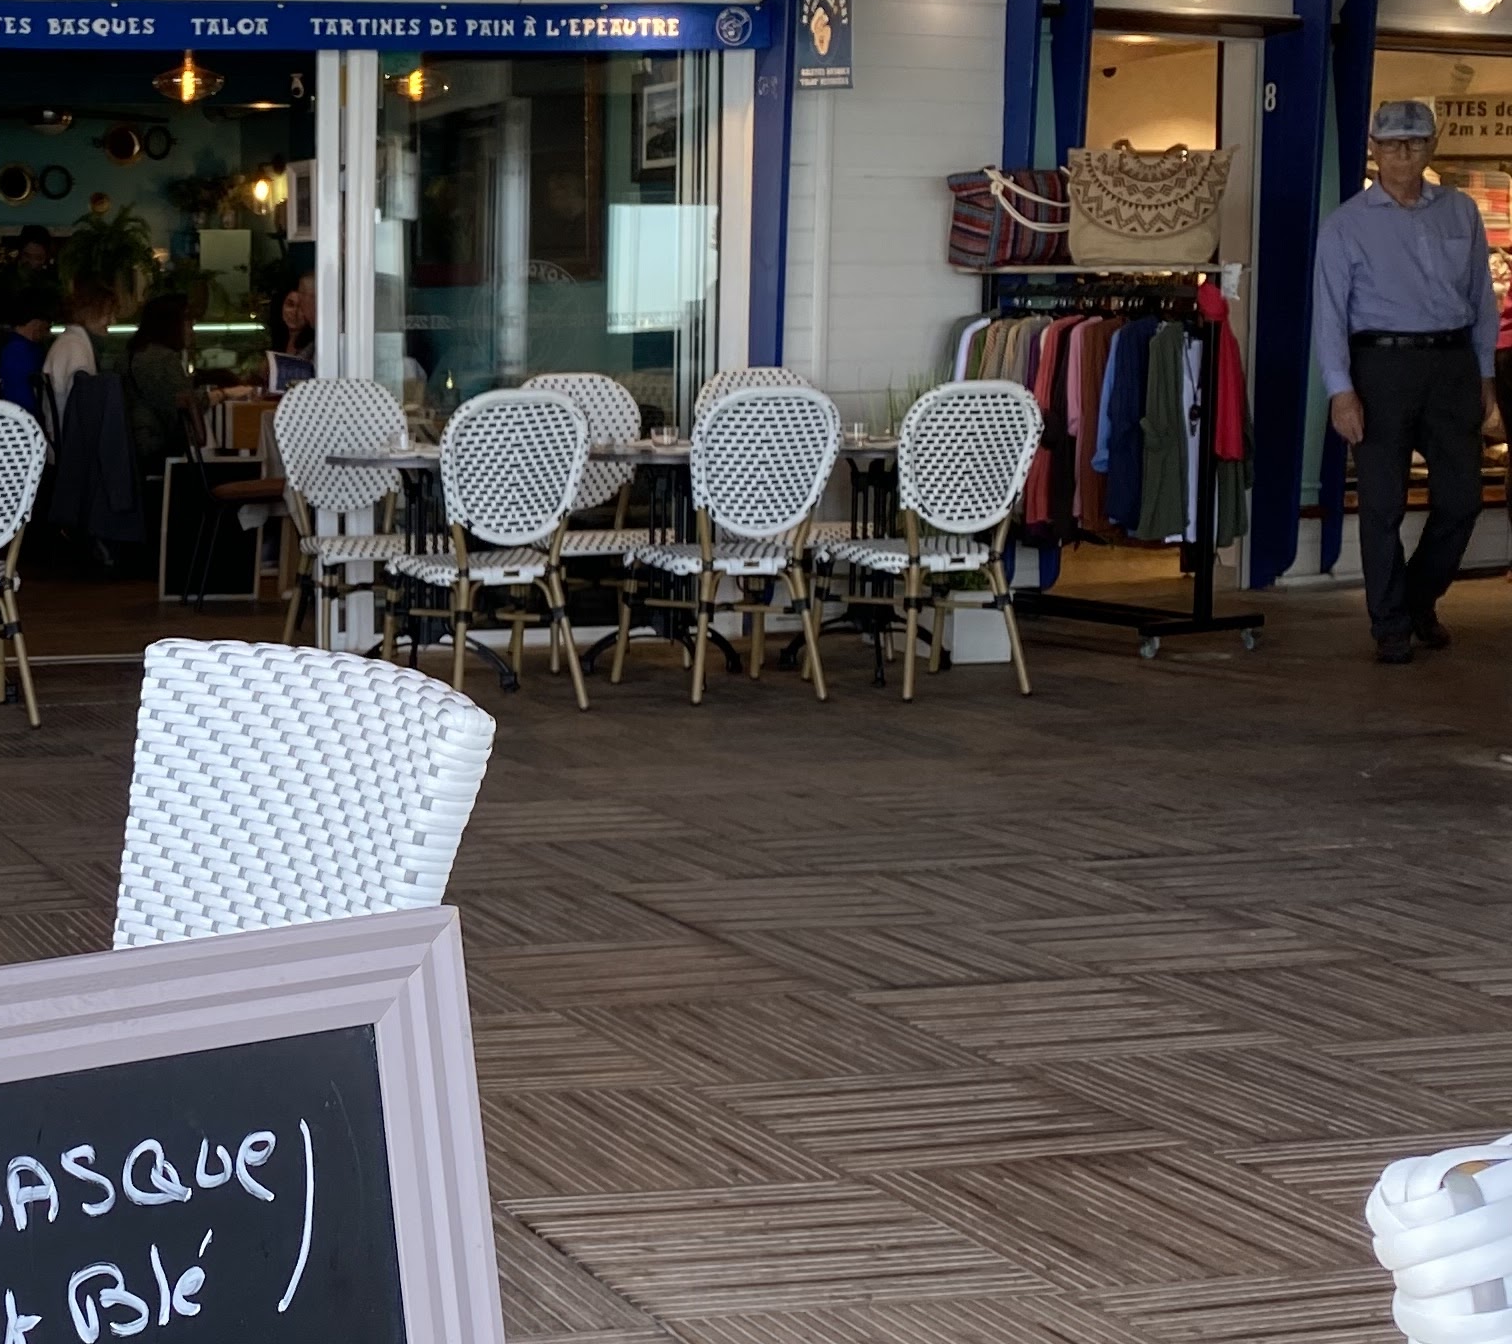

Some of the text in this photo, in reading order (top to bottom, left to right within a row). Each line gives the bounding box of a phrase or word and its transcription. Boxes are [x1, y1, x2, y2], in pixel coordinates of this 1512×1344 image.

[47, 17, 156, 37] BASQUES
[190, 17, 269, 36] TALOA
[310, 17, 422, 37] TARTINES
[430, 18, 458, 37] DE
[465, 18, 516, 37] PAIN
[523, 15, 537, 38] À
[545, 17, 681, 38] L'EPEAUTRE
[1264, 82, 1277, 112] 8
[1480, 126, 1488, 137] x
